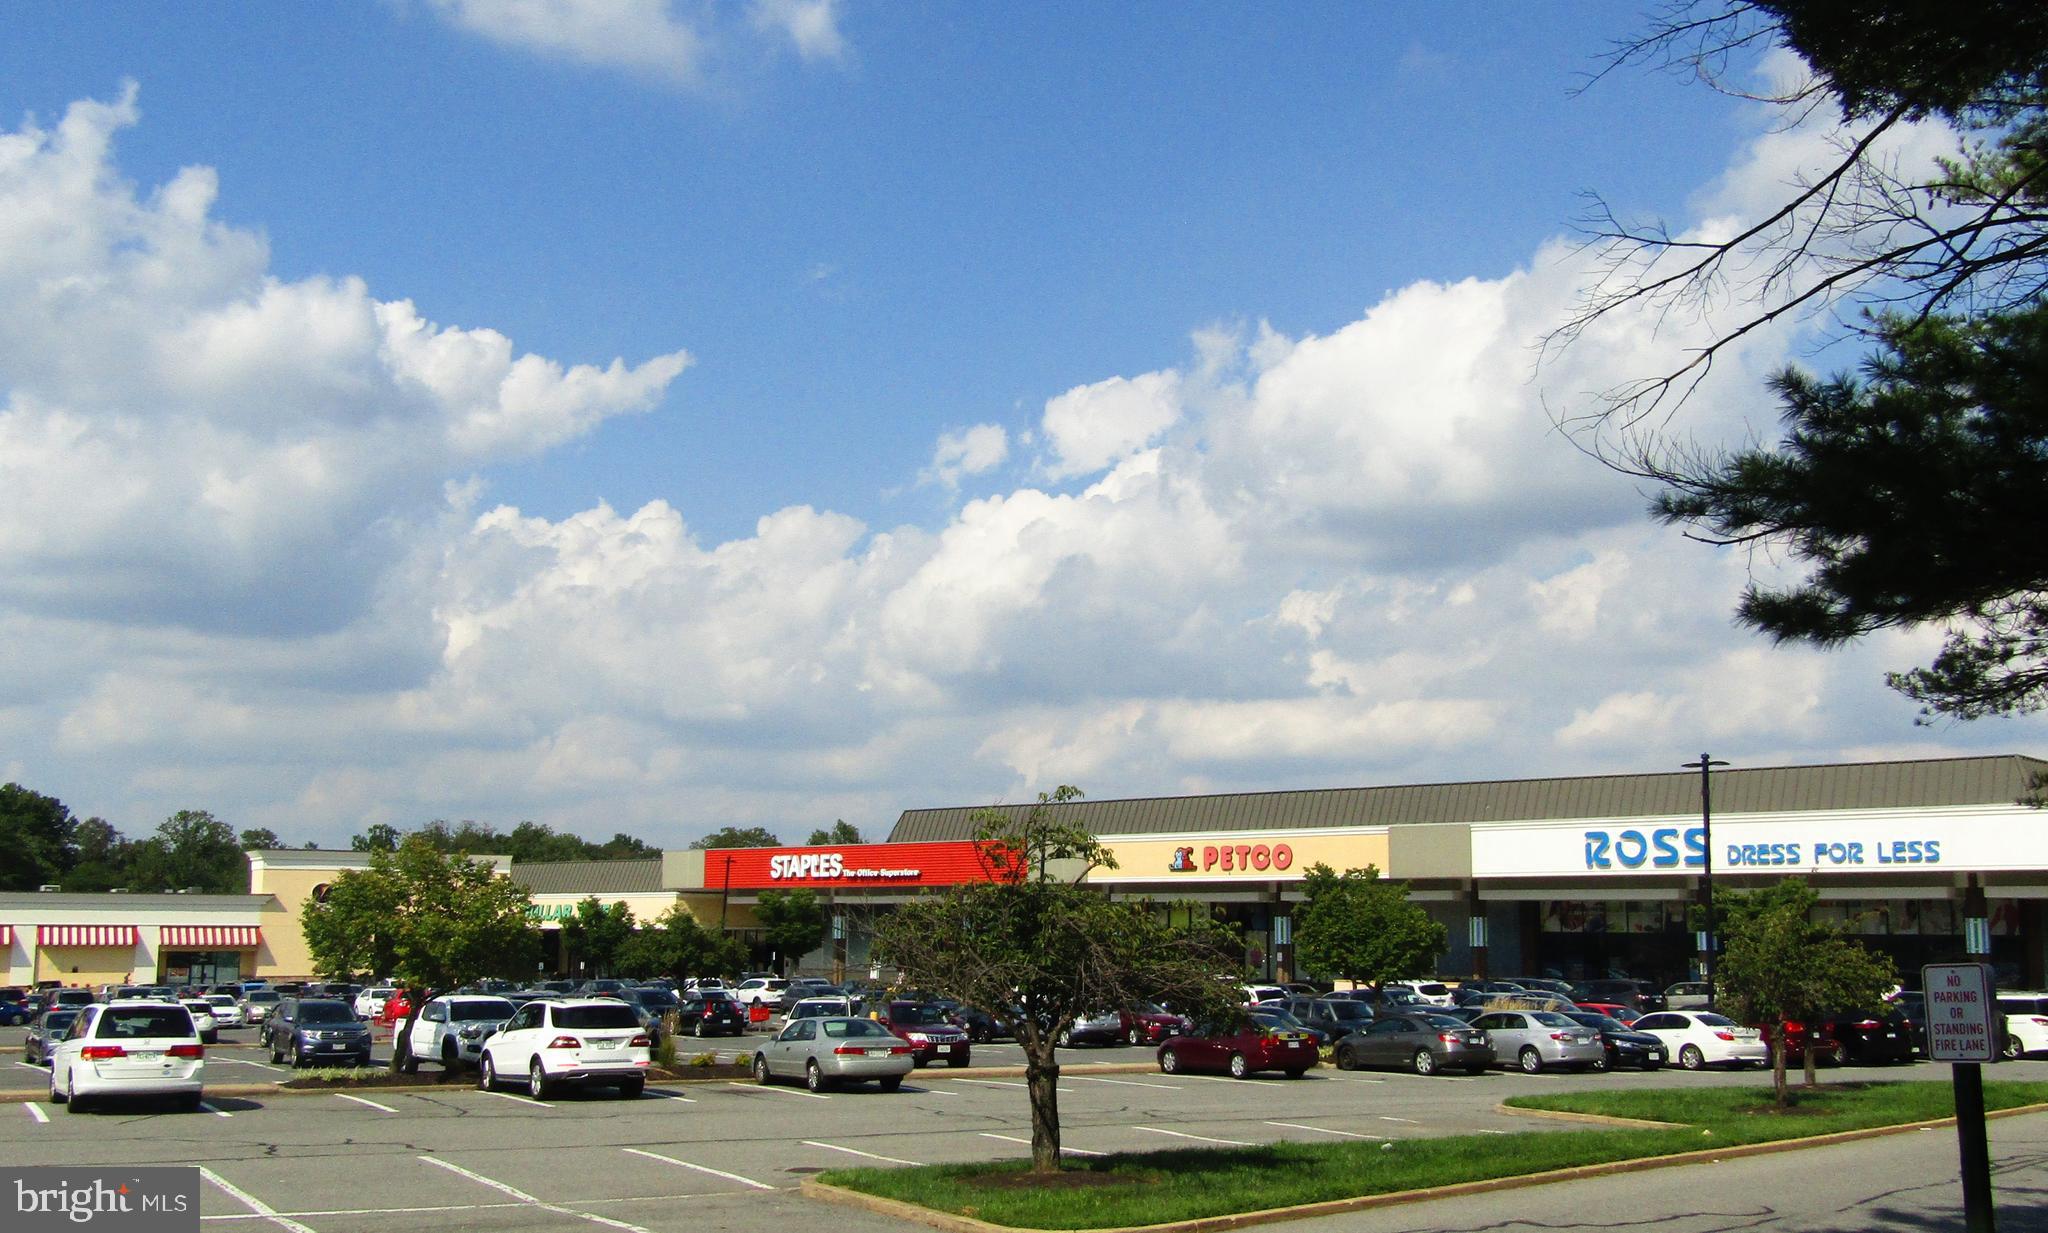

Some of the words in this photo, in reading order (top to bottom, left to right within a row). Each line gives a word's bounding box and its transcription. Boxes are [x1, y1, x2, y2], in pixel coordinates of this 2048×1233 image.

[1584, 827, 1705, 869] ROSS
[1727, 843, 1801, 866] DRESS
[1814, 842, 1864, 865] FOR
[1877, 840, 1941, 865] LESS
[1203, 843, 1293, 872] PETCO
[770, 853, 843, 879] STAPLES
[843, 868, 856, 877] The
[857, 868, 879, 877] Office
[880, 868, 920, 878] Superstore
[1946, 975, 1960, 987] NO
[1934, 991, 1977, 1003] PARKING
[1950, 1007, 1963, 1019] OR
[1934, 1023, 1983, 1035] STANDING
[1935, 1039, 1957, 1051] FIRE
[1960, 1039, 1985, 1051] LANE
